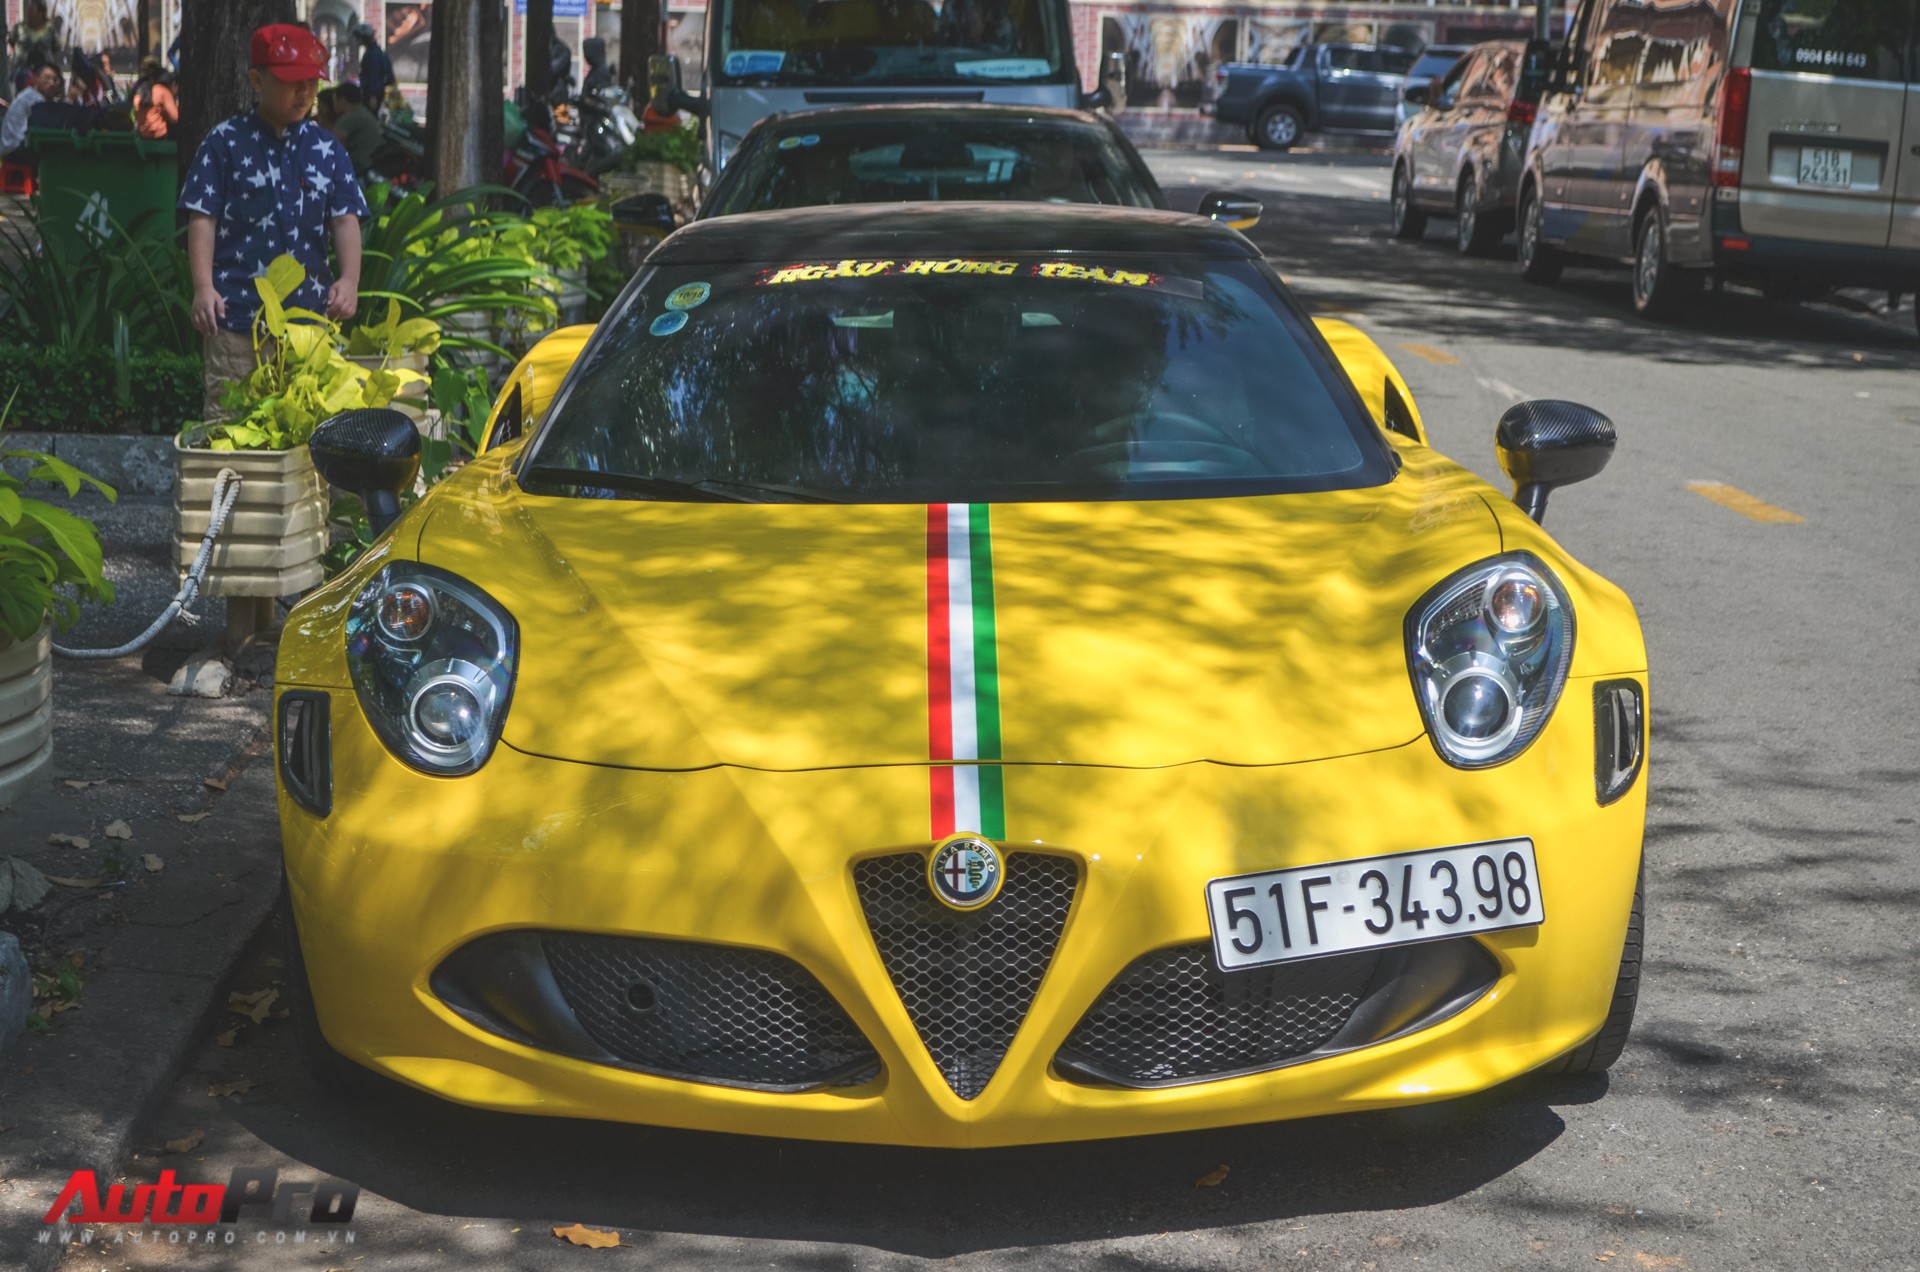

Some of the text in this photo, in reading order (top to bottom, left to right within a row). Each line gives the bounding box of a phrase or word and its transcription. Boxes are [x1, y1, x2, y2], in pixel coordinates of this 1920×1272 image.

[1038, 262, 1149, 286] TEAM
[937, 843, 995, 873] ALFA ROMEO
[1223, 851, 1532, 955] 51F-343.98
